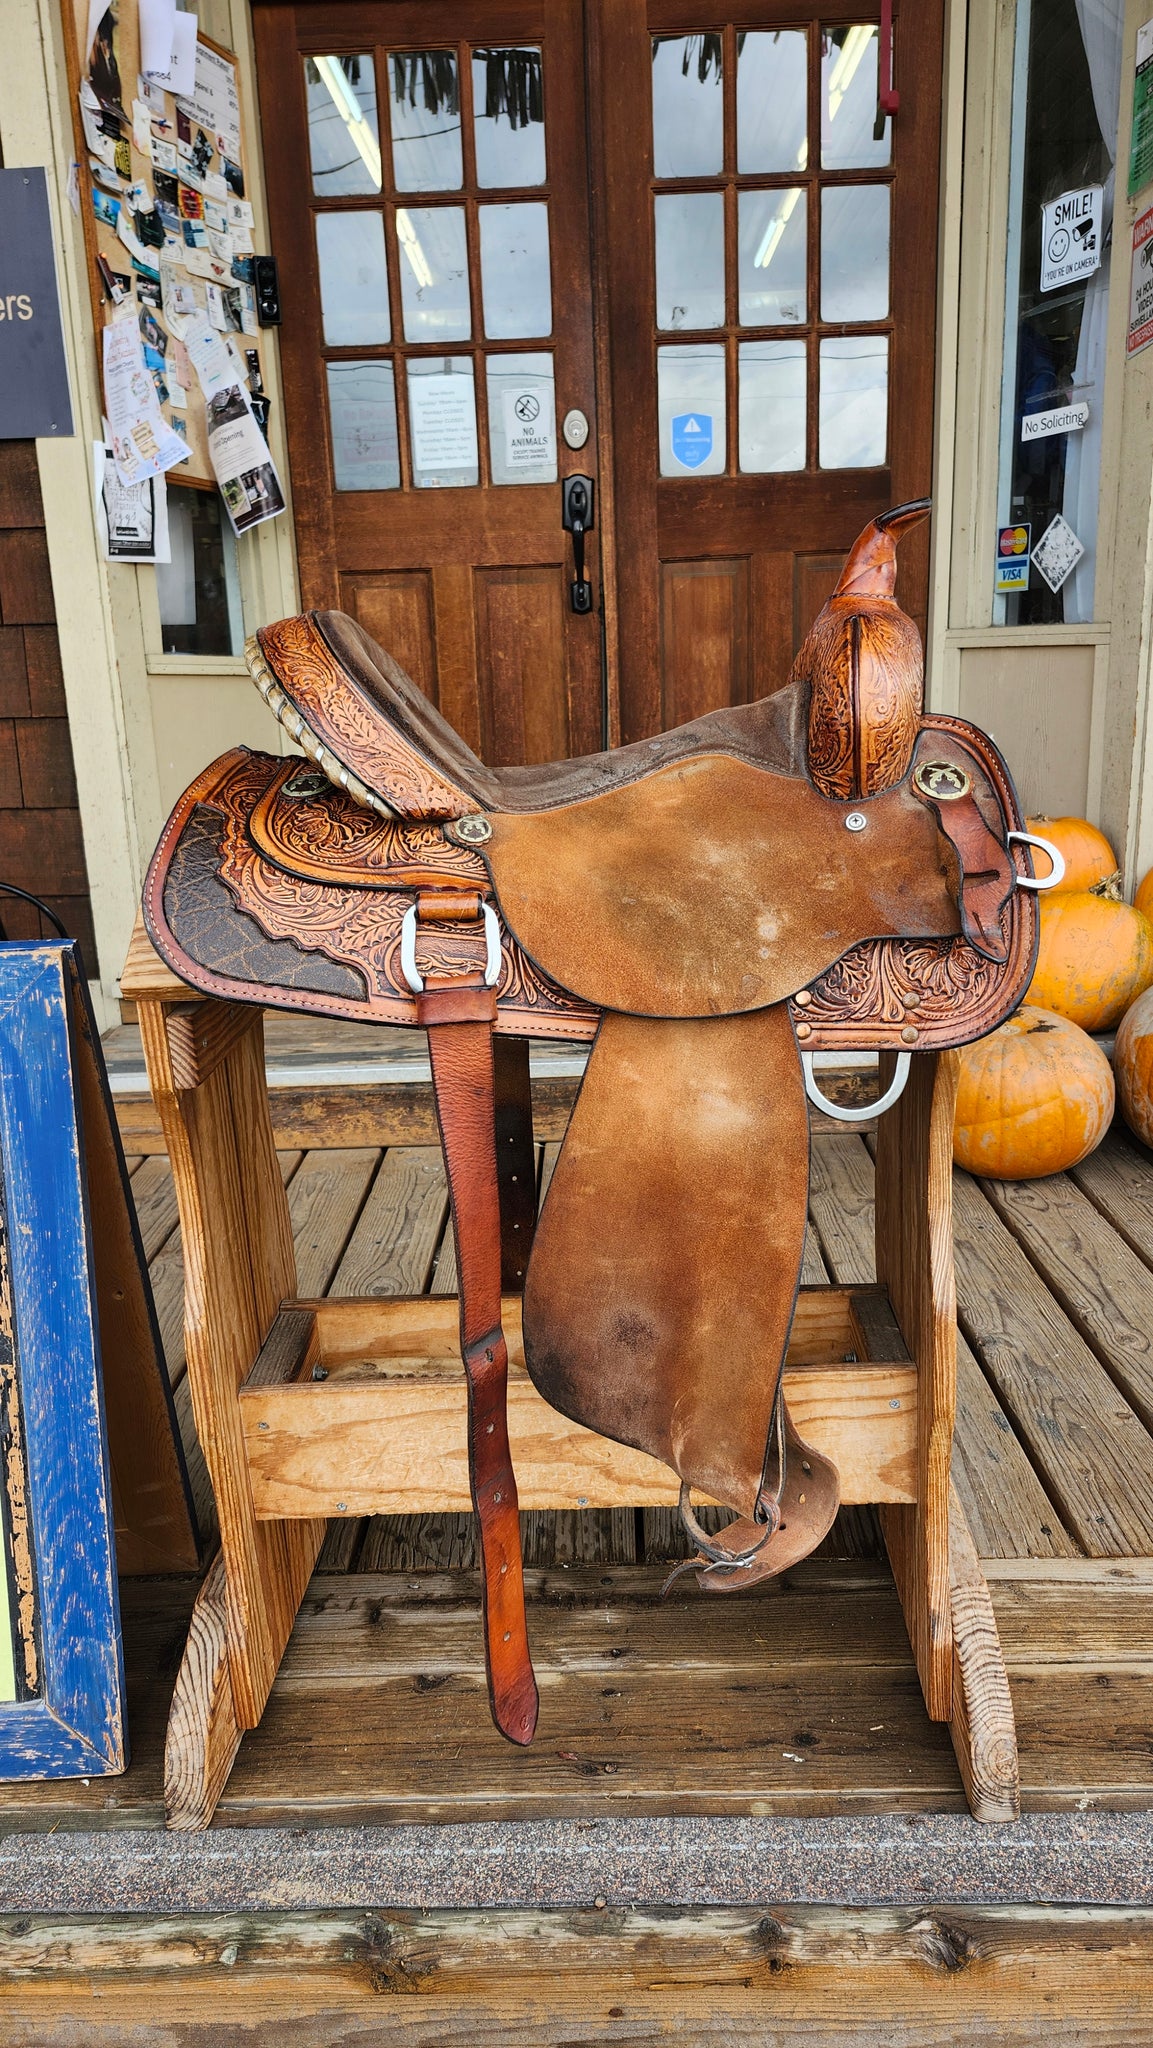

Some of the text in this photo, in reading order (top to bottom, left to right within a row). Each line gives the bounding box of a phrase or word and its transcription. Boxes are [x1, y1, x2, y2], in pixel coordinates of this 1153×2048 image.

[1054, 192, 1093, 226] SMILE!
[1065, 263, 1074, 275] ON
[1025, 412, 1084, 434] No Soliciting
[523, 427, 535, 436] NO
[511, 437, 549, 447] ANIMALS
[1002, 568, 1022, 581] VISA
